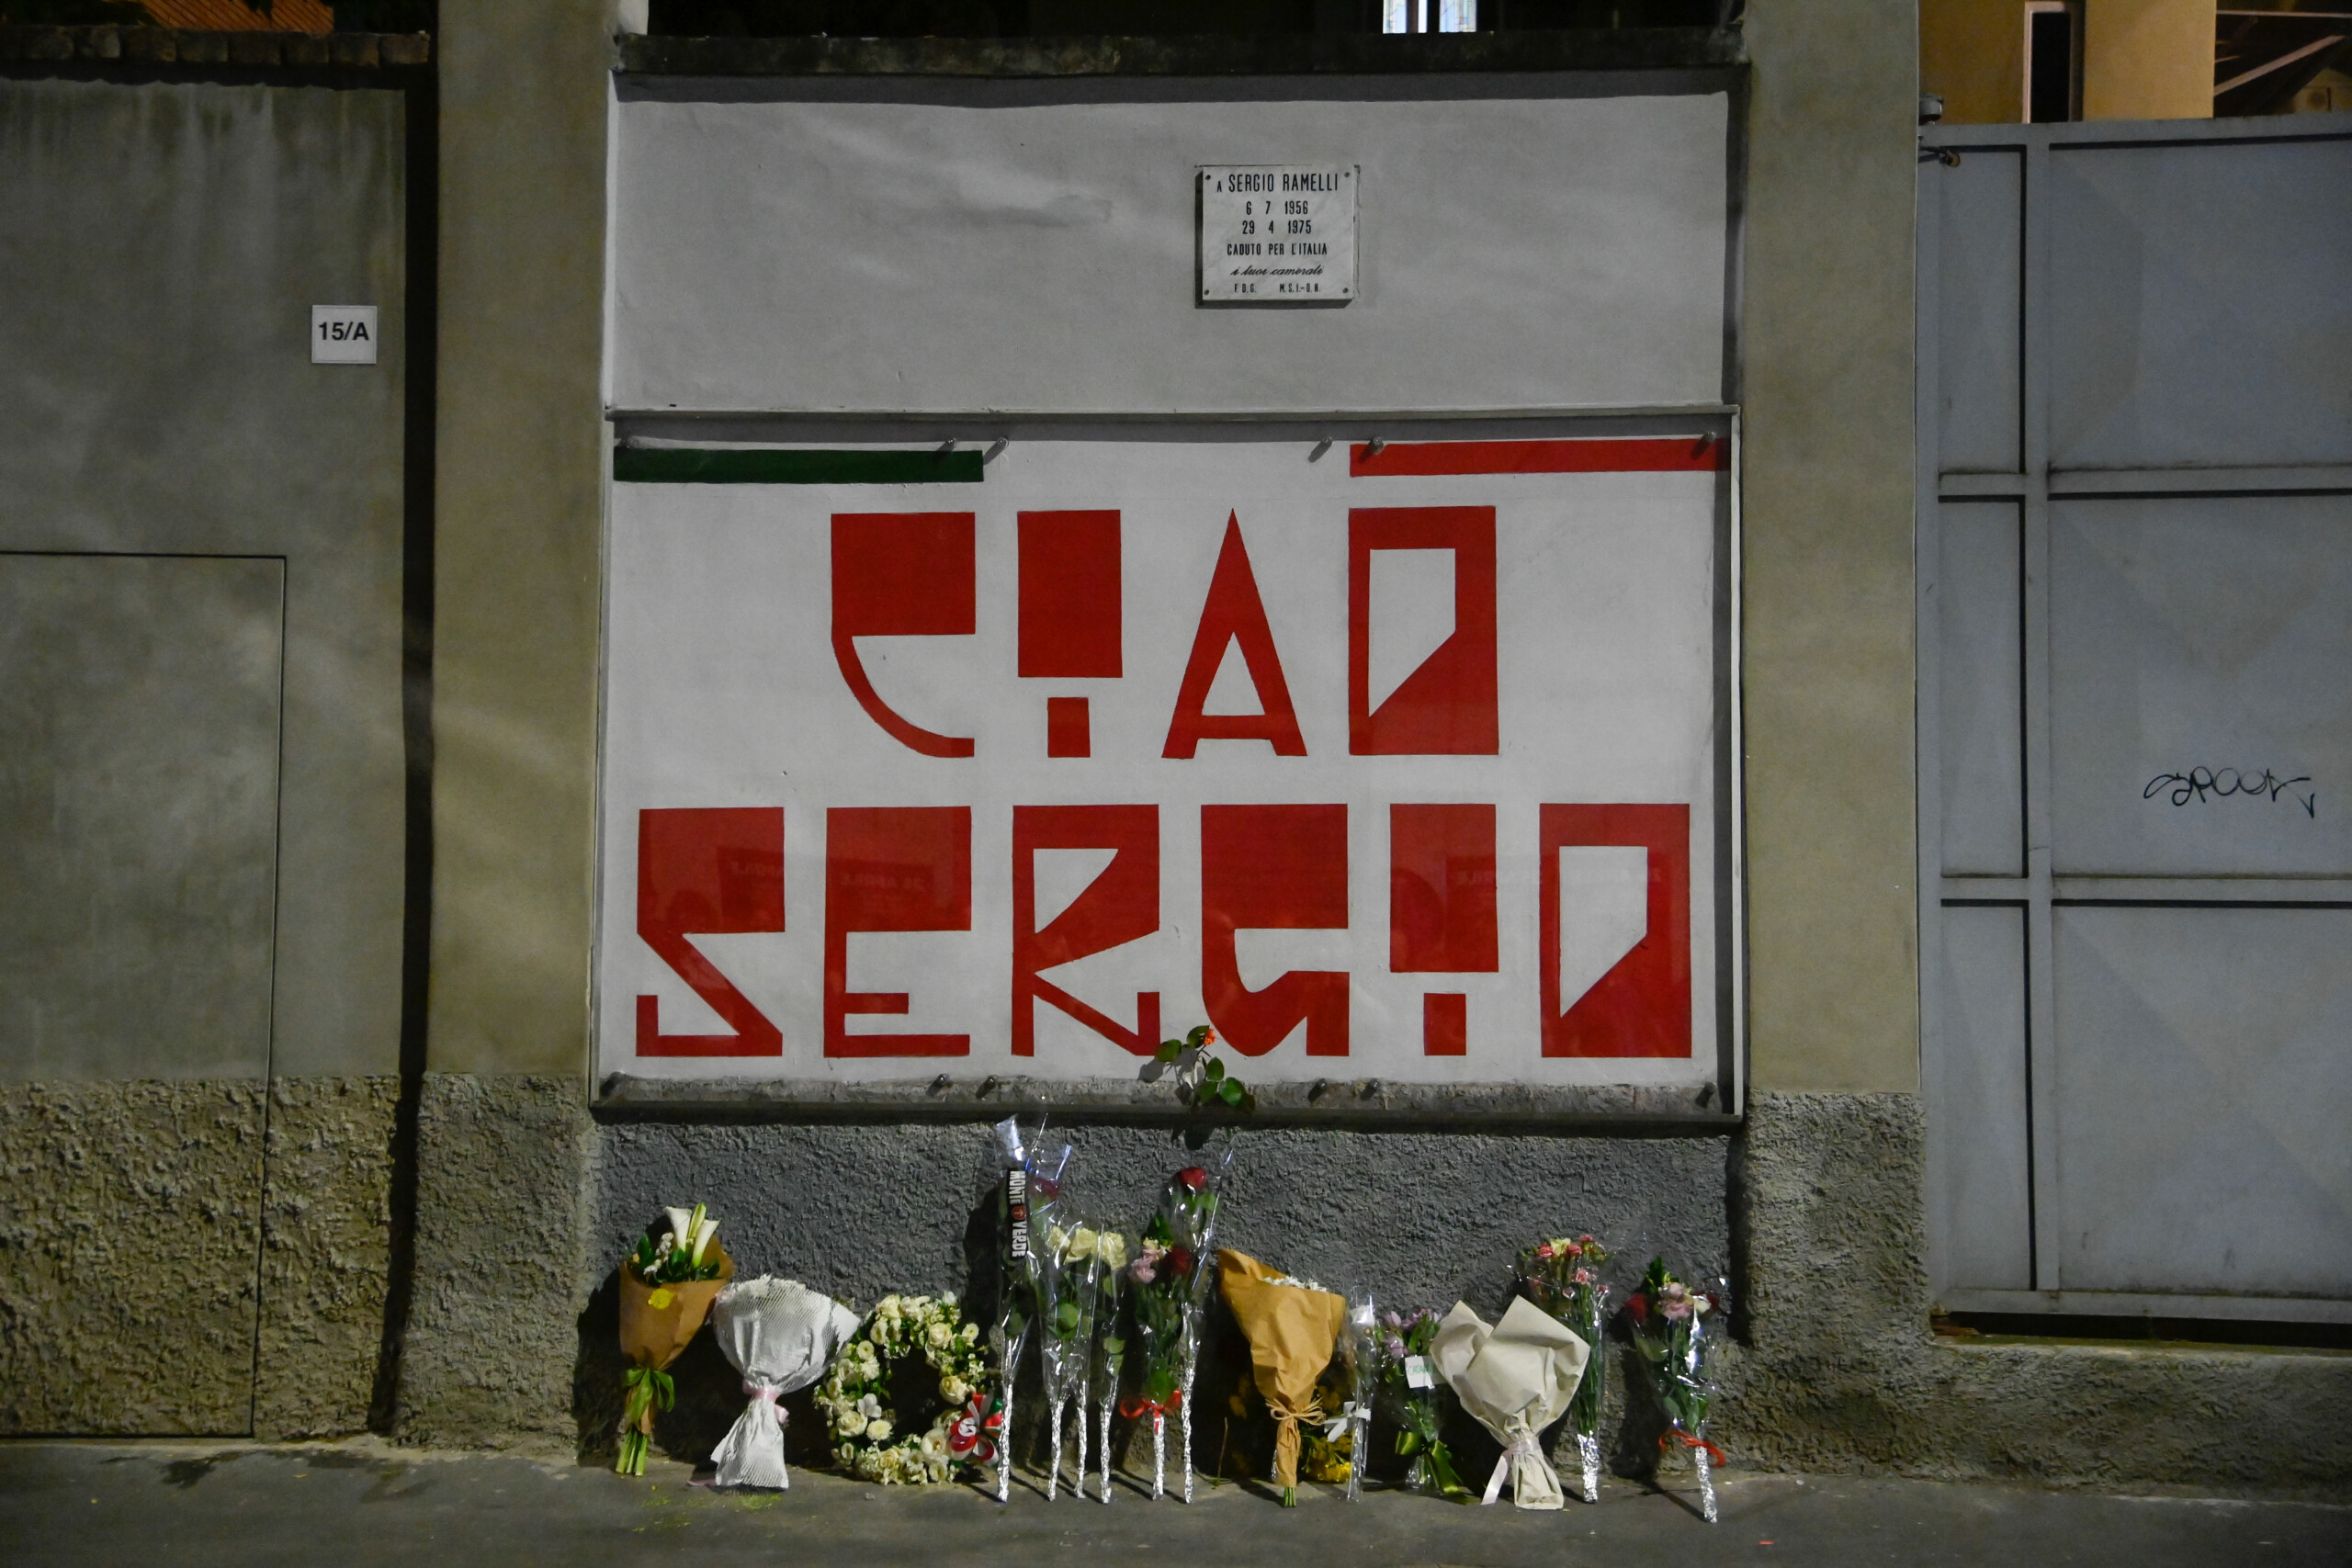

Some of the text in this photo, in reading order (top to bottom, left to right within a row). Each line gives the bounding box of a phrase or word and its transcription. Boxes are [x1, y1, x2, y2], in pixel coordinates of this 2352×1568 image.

[1216, 173, 1339, 193] A SERGIO RAMELLI
[1246, 200, 1308, 216] 6 7 1956
[1242, 220, 1312, 235] 29 4 1975
[1227, 243, 1328, 256] CADUTO PER L'ITALIA
[319, 321, 369, 341] 15/A
[831, 505, 1499, 760] CIAO
[636, 803, 1692, 1059] SERGIO
[1009, 1170, 1028, 1258] MONTE VERDE
